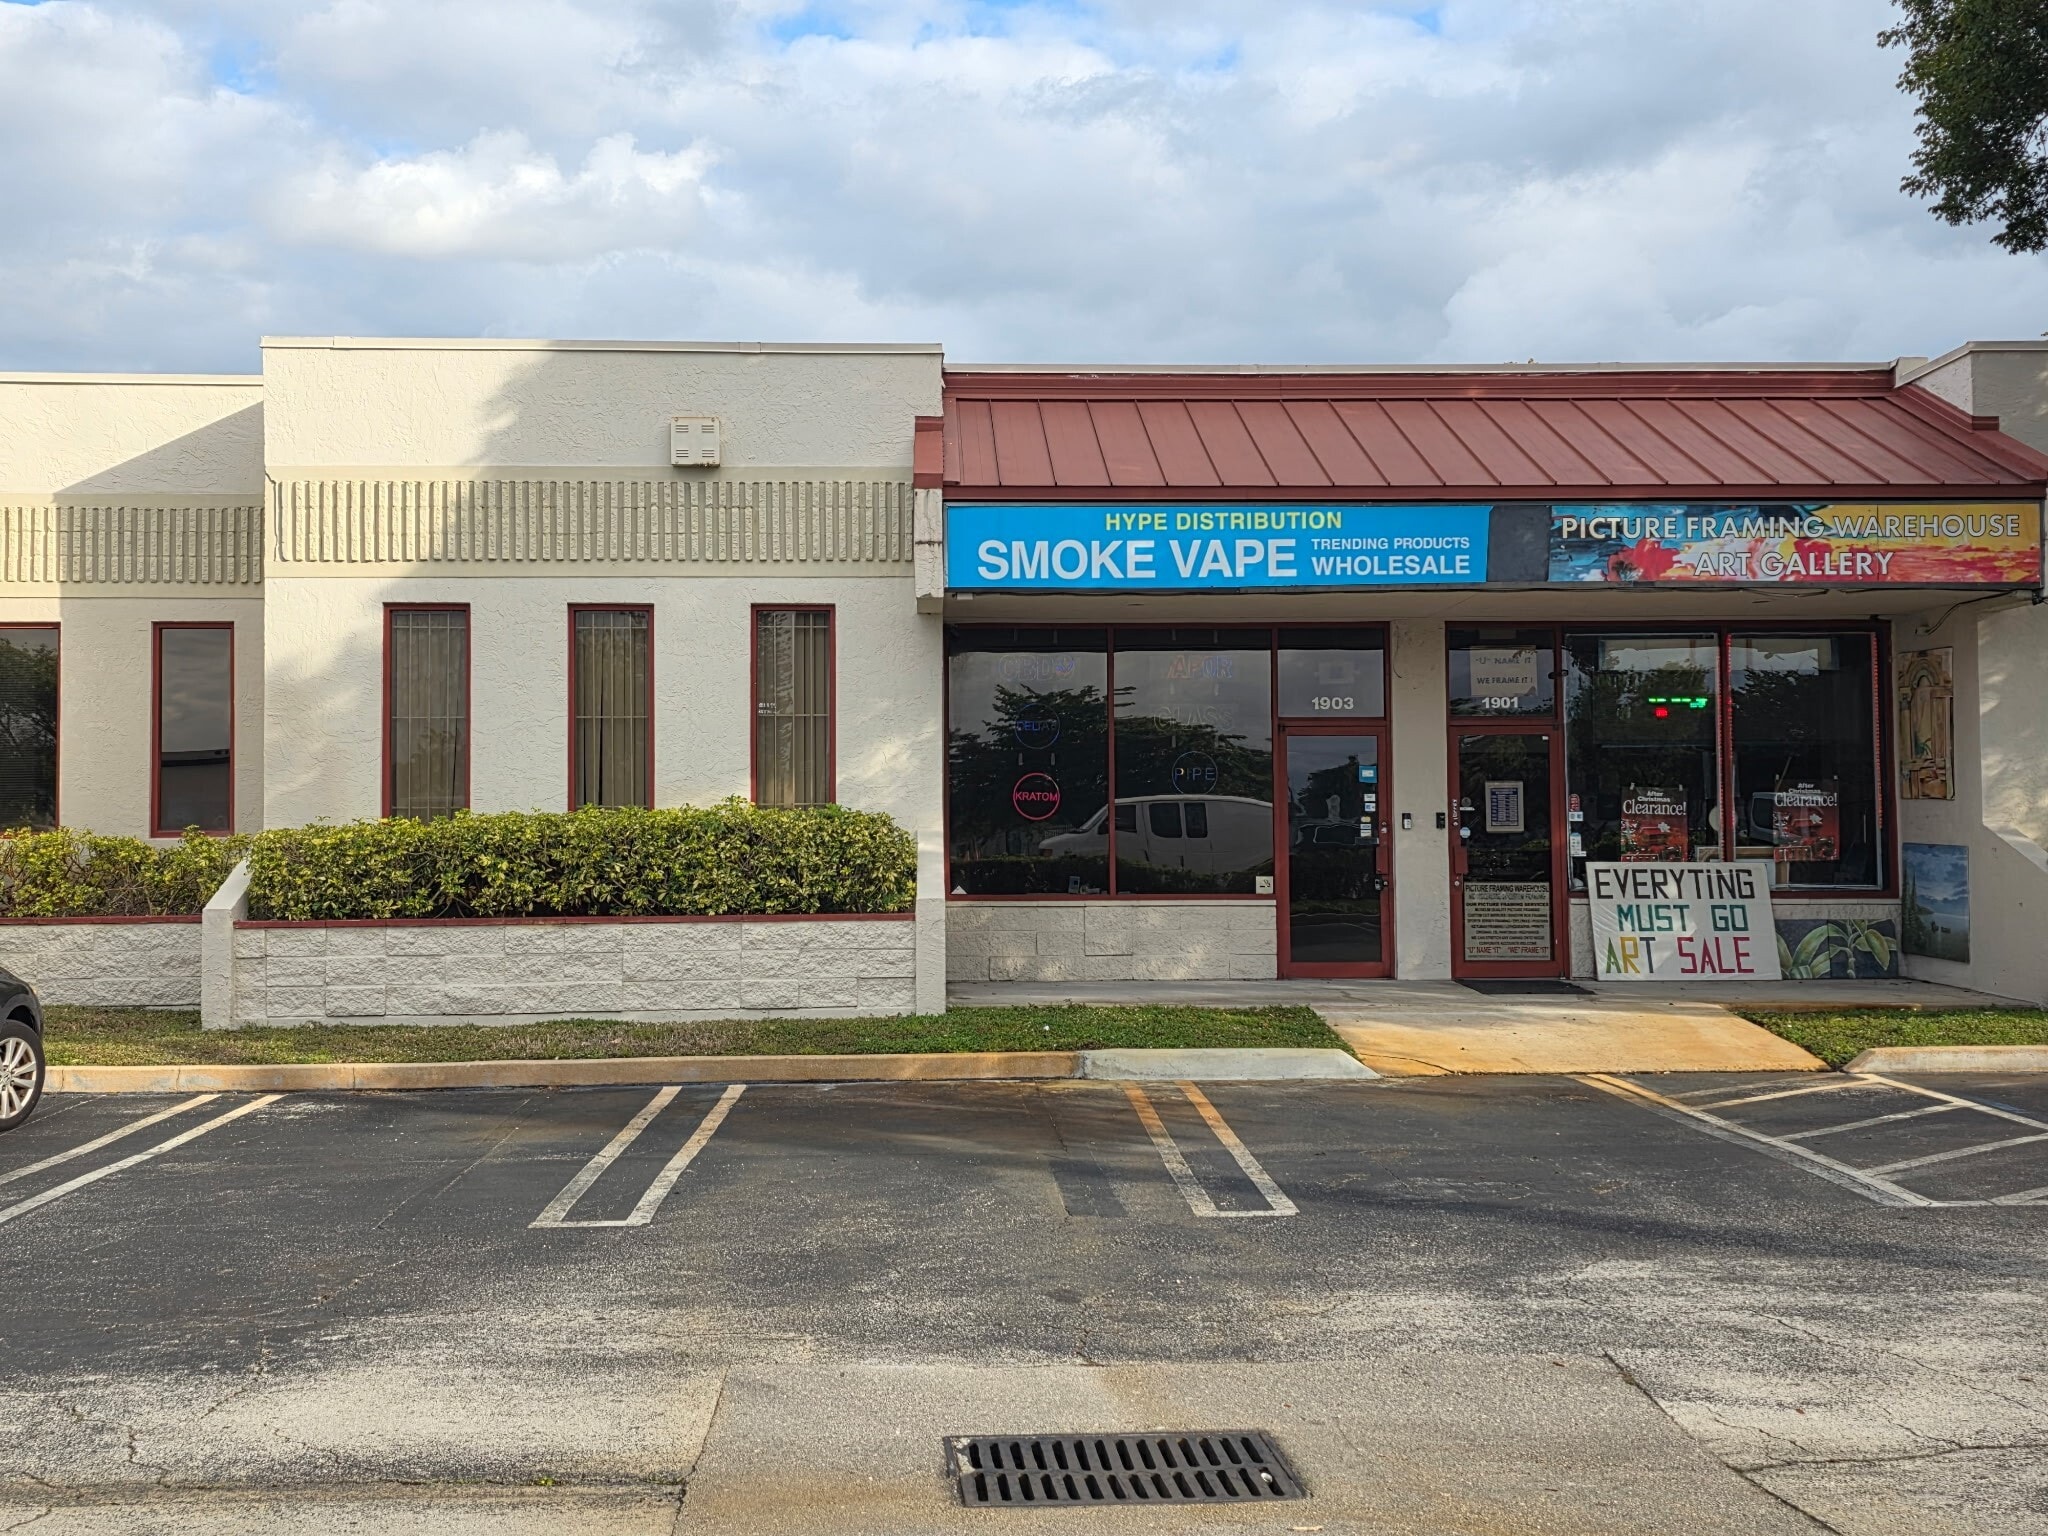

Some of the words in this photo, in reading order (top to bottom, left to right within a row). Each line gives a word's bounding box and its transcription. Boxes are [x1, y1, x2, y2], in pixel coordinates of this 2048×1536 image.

[1105, 512, 1168, 531] HYPE
[1176, 511, 1342, 531] DISTRIBUTION
[1561, 516, 1677, 539] PICTURE
[1687, 515, 1825, 539] FRAMING
[1833, 513, 2020, 538] WAREHOUSE
[1311, 538, 1388, 550] TRENDING
[1393, 537, 1470, 549] PRODUCTS
[977, 539, 1156, 580] SMOKE
[1169, 537, 1297, 578] VAPE
[1311, 554, 1470, 576] WHOLESALE
[1694, 552, 1752, 576] ART
[1760, 551, 1895, 576] GALLERY
[1494, 656, 1520, 665] NAME
[1476, 676, 1490, 685] WE
[1492, 676, 1520, 684] FRAME
[1311, 697, 1354, 710] 1903
[1481, 696, 1519, 709] 1901
[1175, 767, 1216, 781] PIPE
[1015, 792, 1058, 801] KRATOM
[1775, 792, 1838, 807] Clearance!
[1623, 799, 1687, 815] Clearance!
[1594, 868, 1755, 899] EVERYTING
[1617, 904, 1690, 931] MUST
[1711, 904, 1749, 931] GO
[1606, 936, 1656, 974] ART
[1676, 936, 1755, 974] SALE
